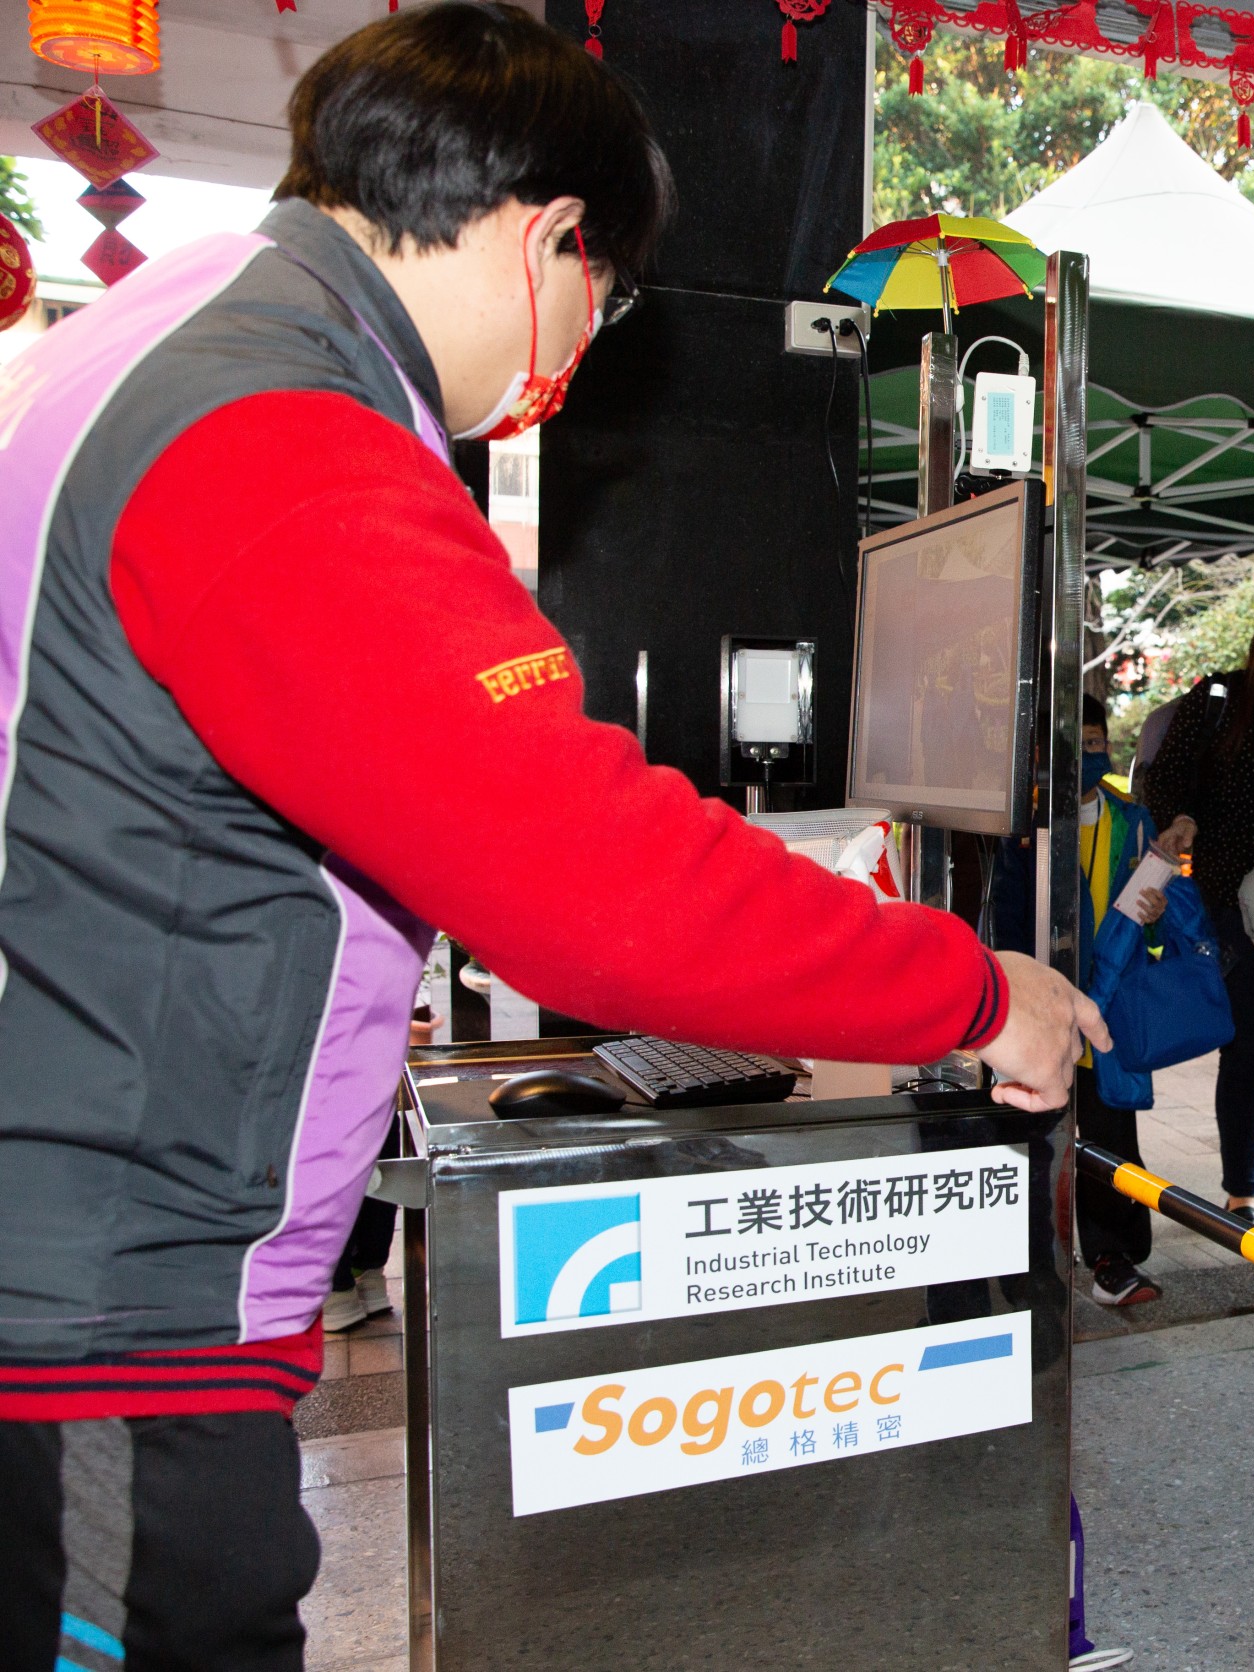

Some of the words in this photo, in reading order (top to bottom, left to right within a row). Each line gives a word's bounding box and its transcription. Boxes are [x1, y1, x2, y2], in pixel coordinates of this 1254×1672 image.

[685, 1163, 1019, 1239] 工業技術研究院
[685, 1244, 800, 1276] Industrial
[806, 1233, 931, 1262] Technology
[686, 1273, 796, 1304] Research
[803, 1263, 896, 1290] Institute
[572, 1363, 905, 1456] Sogotec
[740, 1414, 902, 1466] 總格精密
